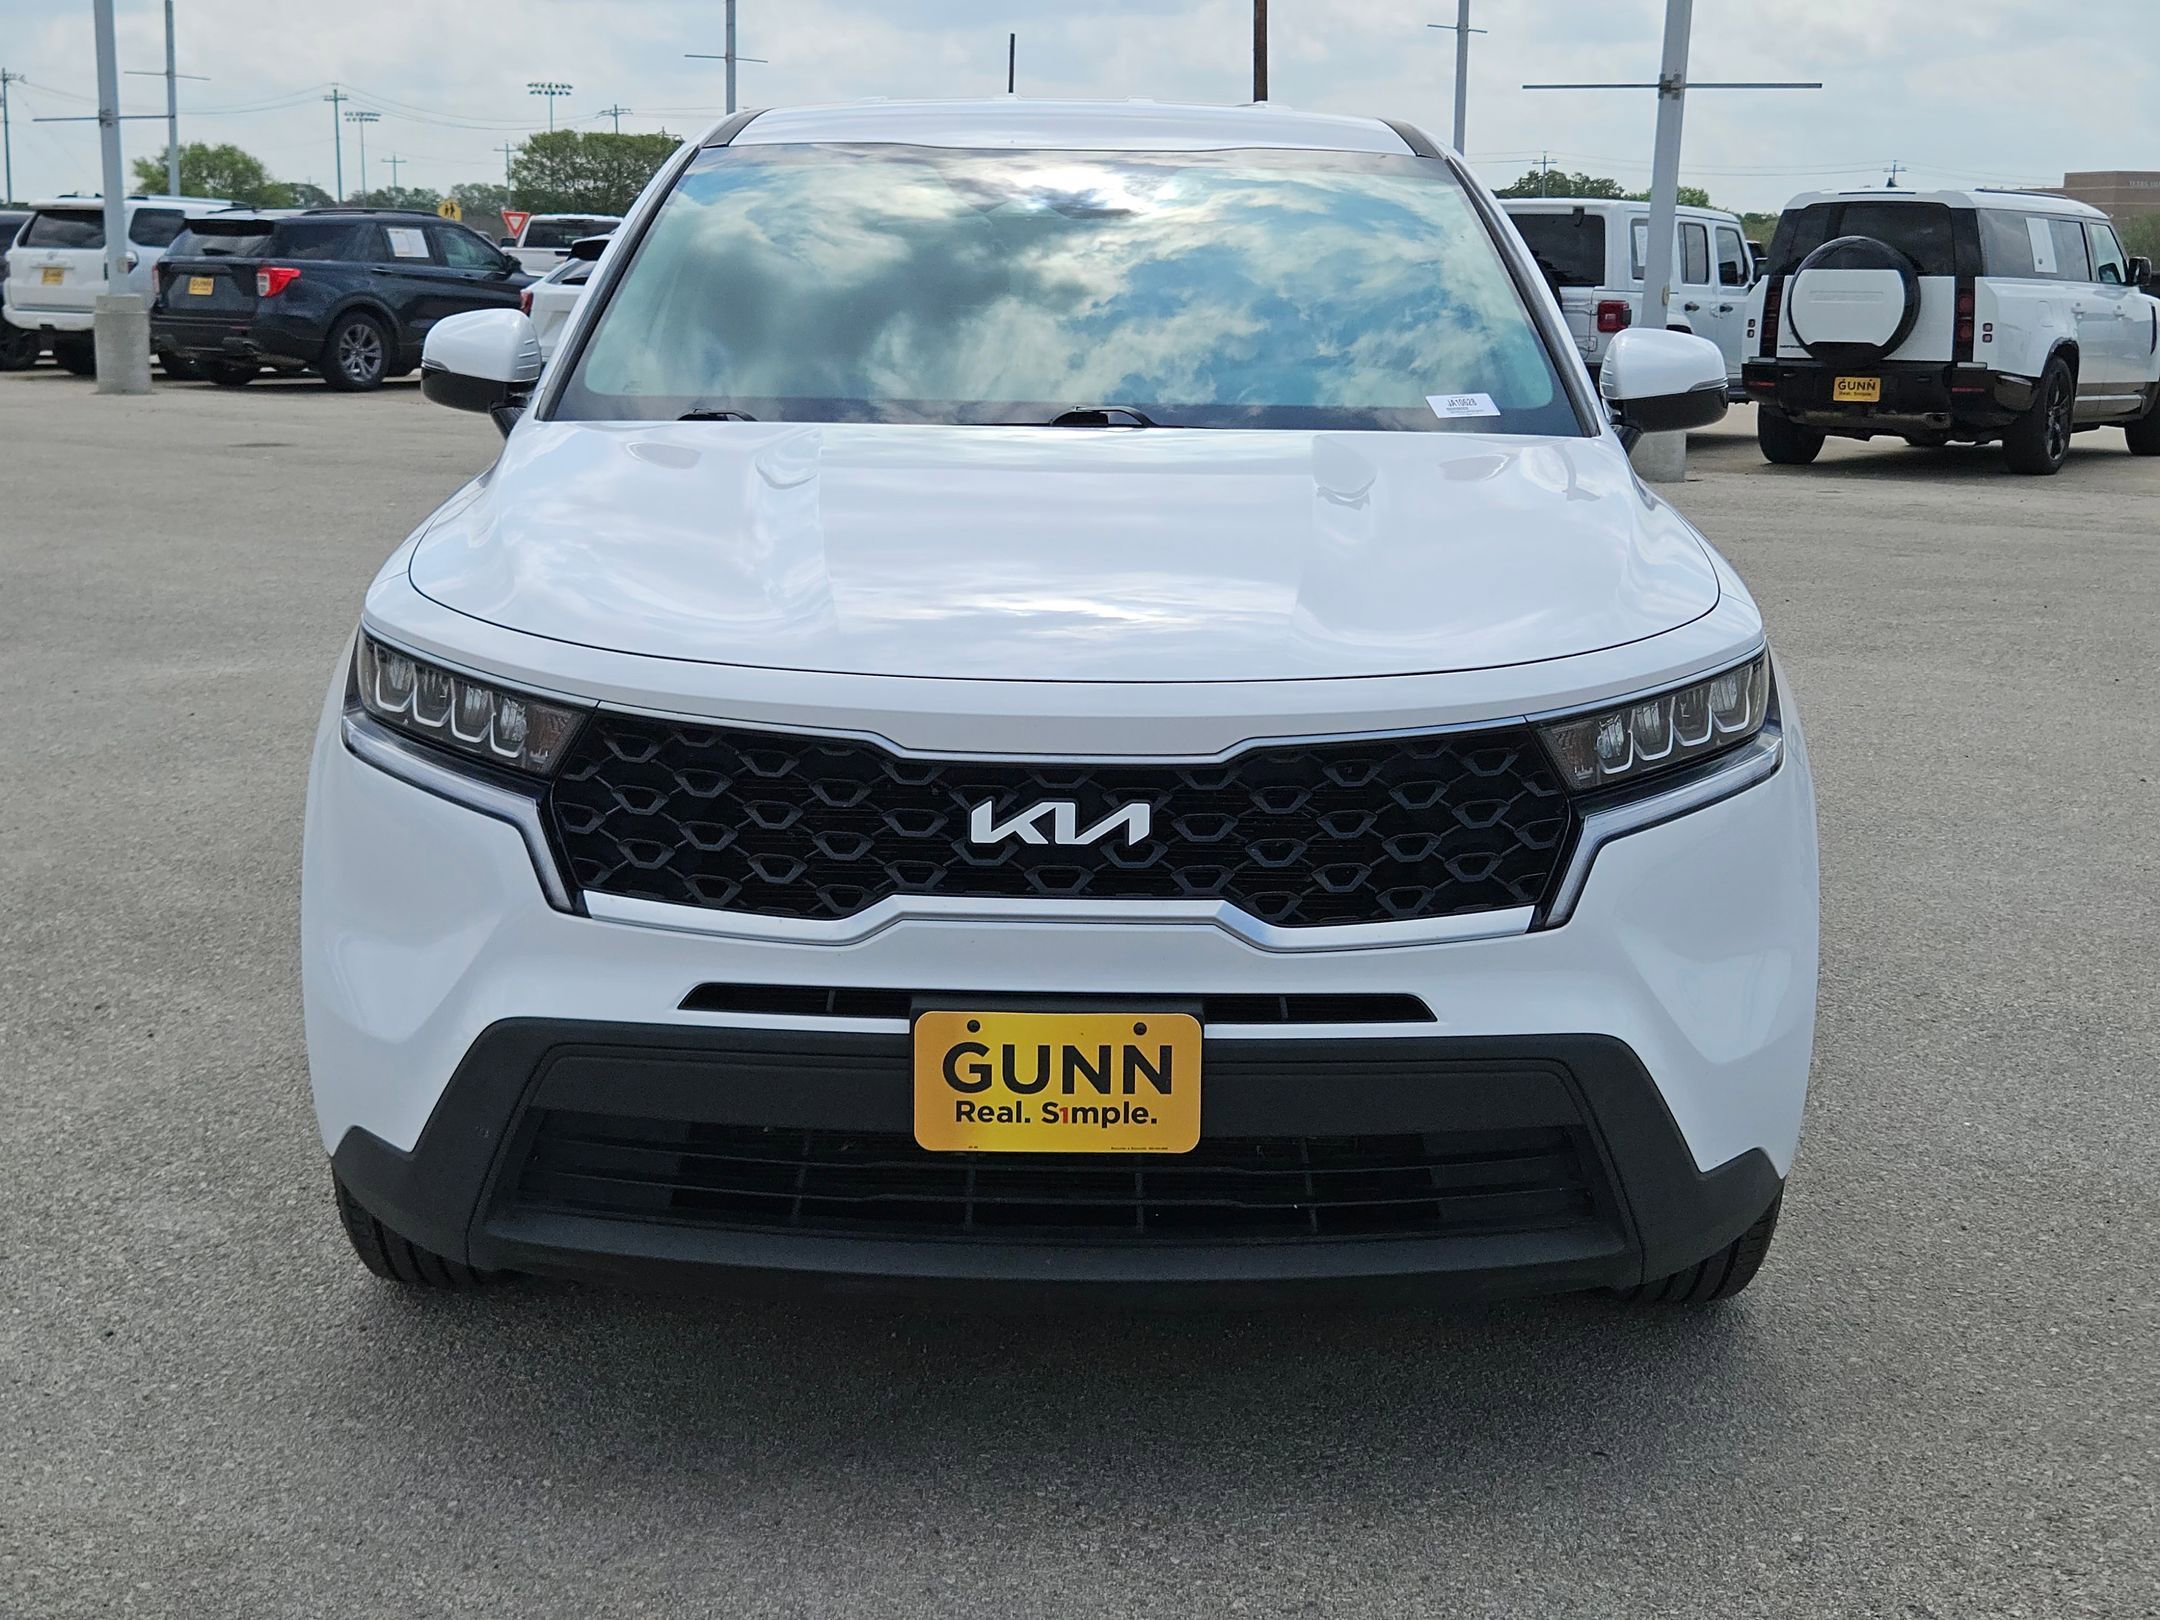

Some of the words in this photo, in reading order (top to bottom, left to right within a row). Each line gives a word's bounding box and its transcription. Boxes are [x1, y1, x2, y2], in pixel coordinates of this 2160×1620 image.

[1838, 381, 1876, 391] GUNN
[971, 800, 1150, 847] KIA
[942, 1041, 1173, 1095] GUNN
[955, 1100, 1031, 1125] Real.
[1041, 1101, 1158, 1129] S1mple.
